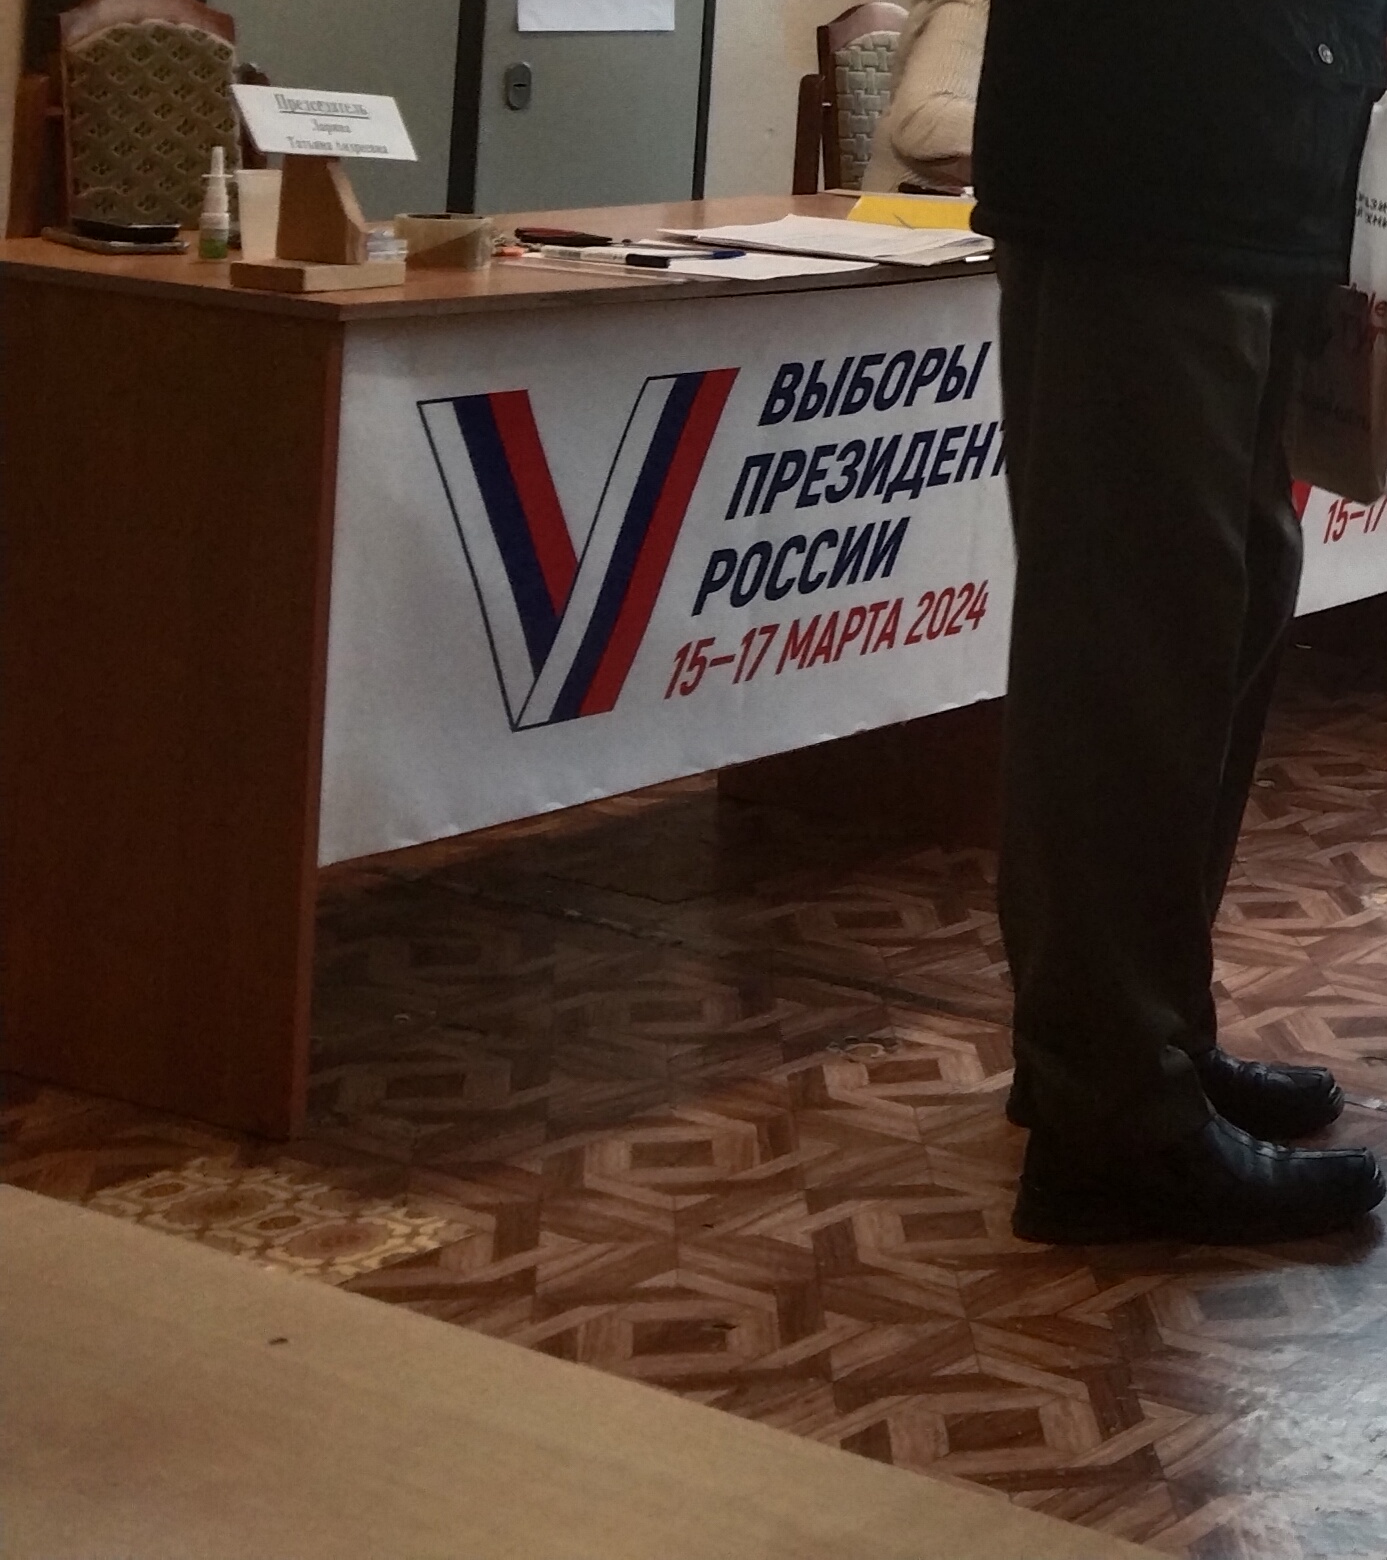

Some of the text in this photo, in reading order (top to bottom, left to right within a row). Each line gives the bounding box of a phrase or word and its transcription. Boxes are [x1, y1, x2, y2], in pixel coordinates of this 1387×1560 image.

[273, 93, 369, 117] Председатель
[757, 341, 993, 427] ВЫБОРЫ
[724, 420, 1008, 520] ПРЕЗИДЕНТ
[691, 516, 911, 617] РОССИИ
[775, 597, 904, 676] МАРТА
[903, 579, 989, 646] 2024
